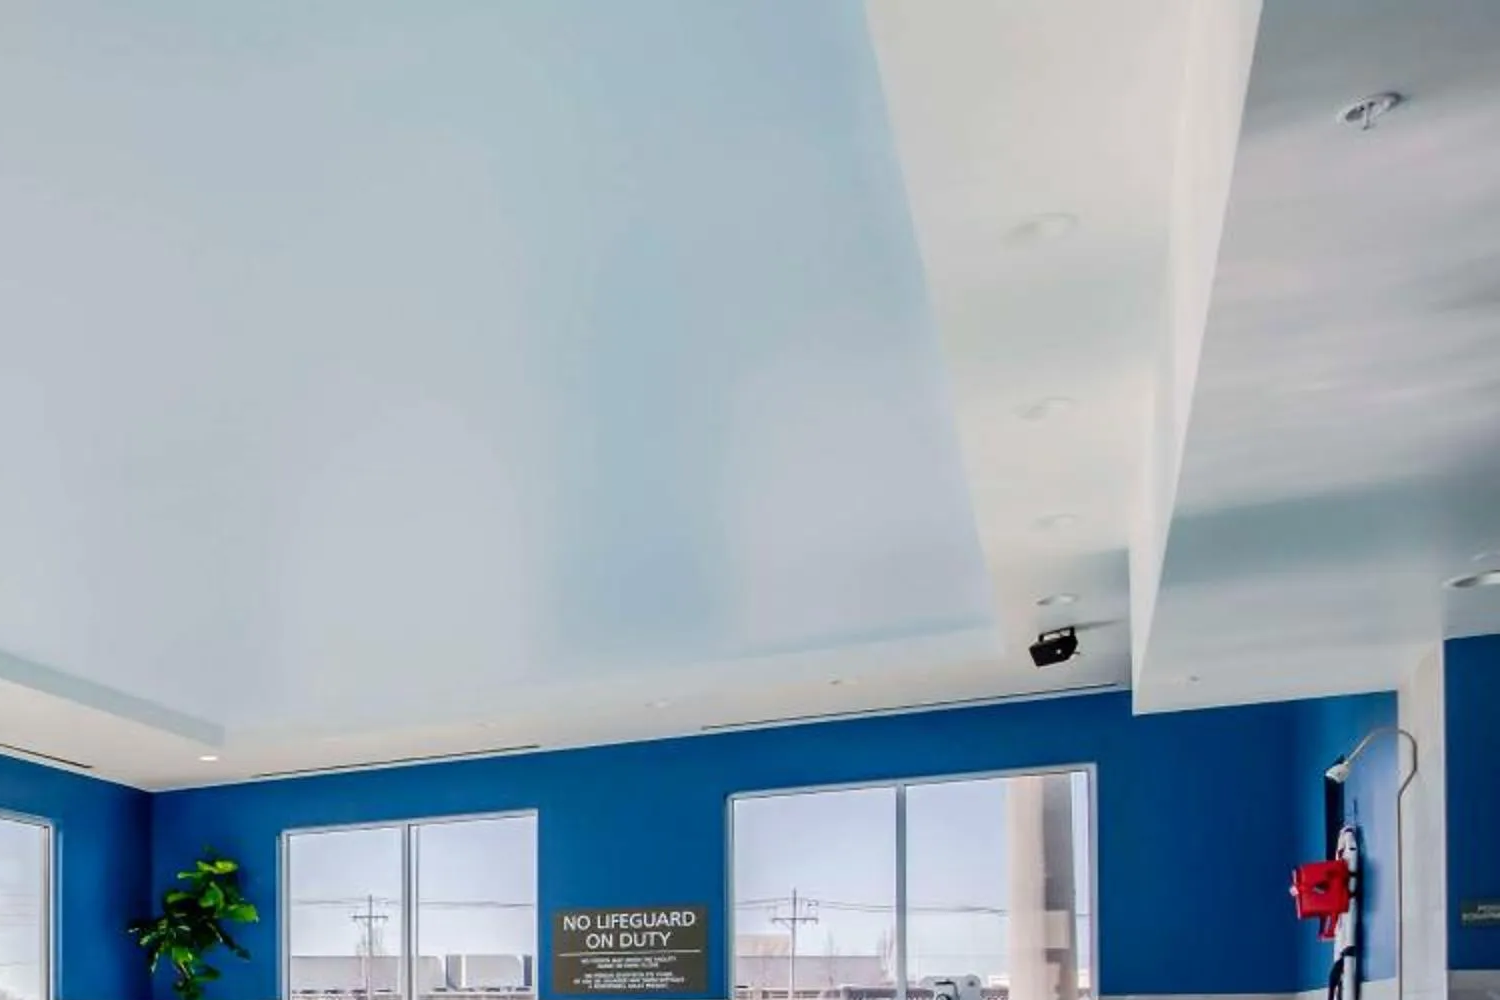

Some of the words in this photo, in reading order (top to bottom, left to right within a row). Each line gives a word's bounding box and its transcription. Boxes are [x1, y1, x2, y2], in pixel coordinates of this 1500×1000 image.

[563, 915, 591, 931] NO
[597, 911, 696, 930] LIFEGUARD
[586, 933, 613, 949] ON
[620, 931, 672, 947] DUTY
